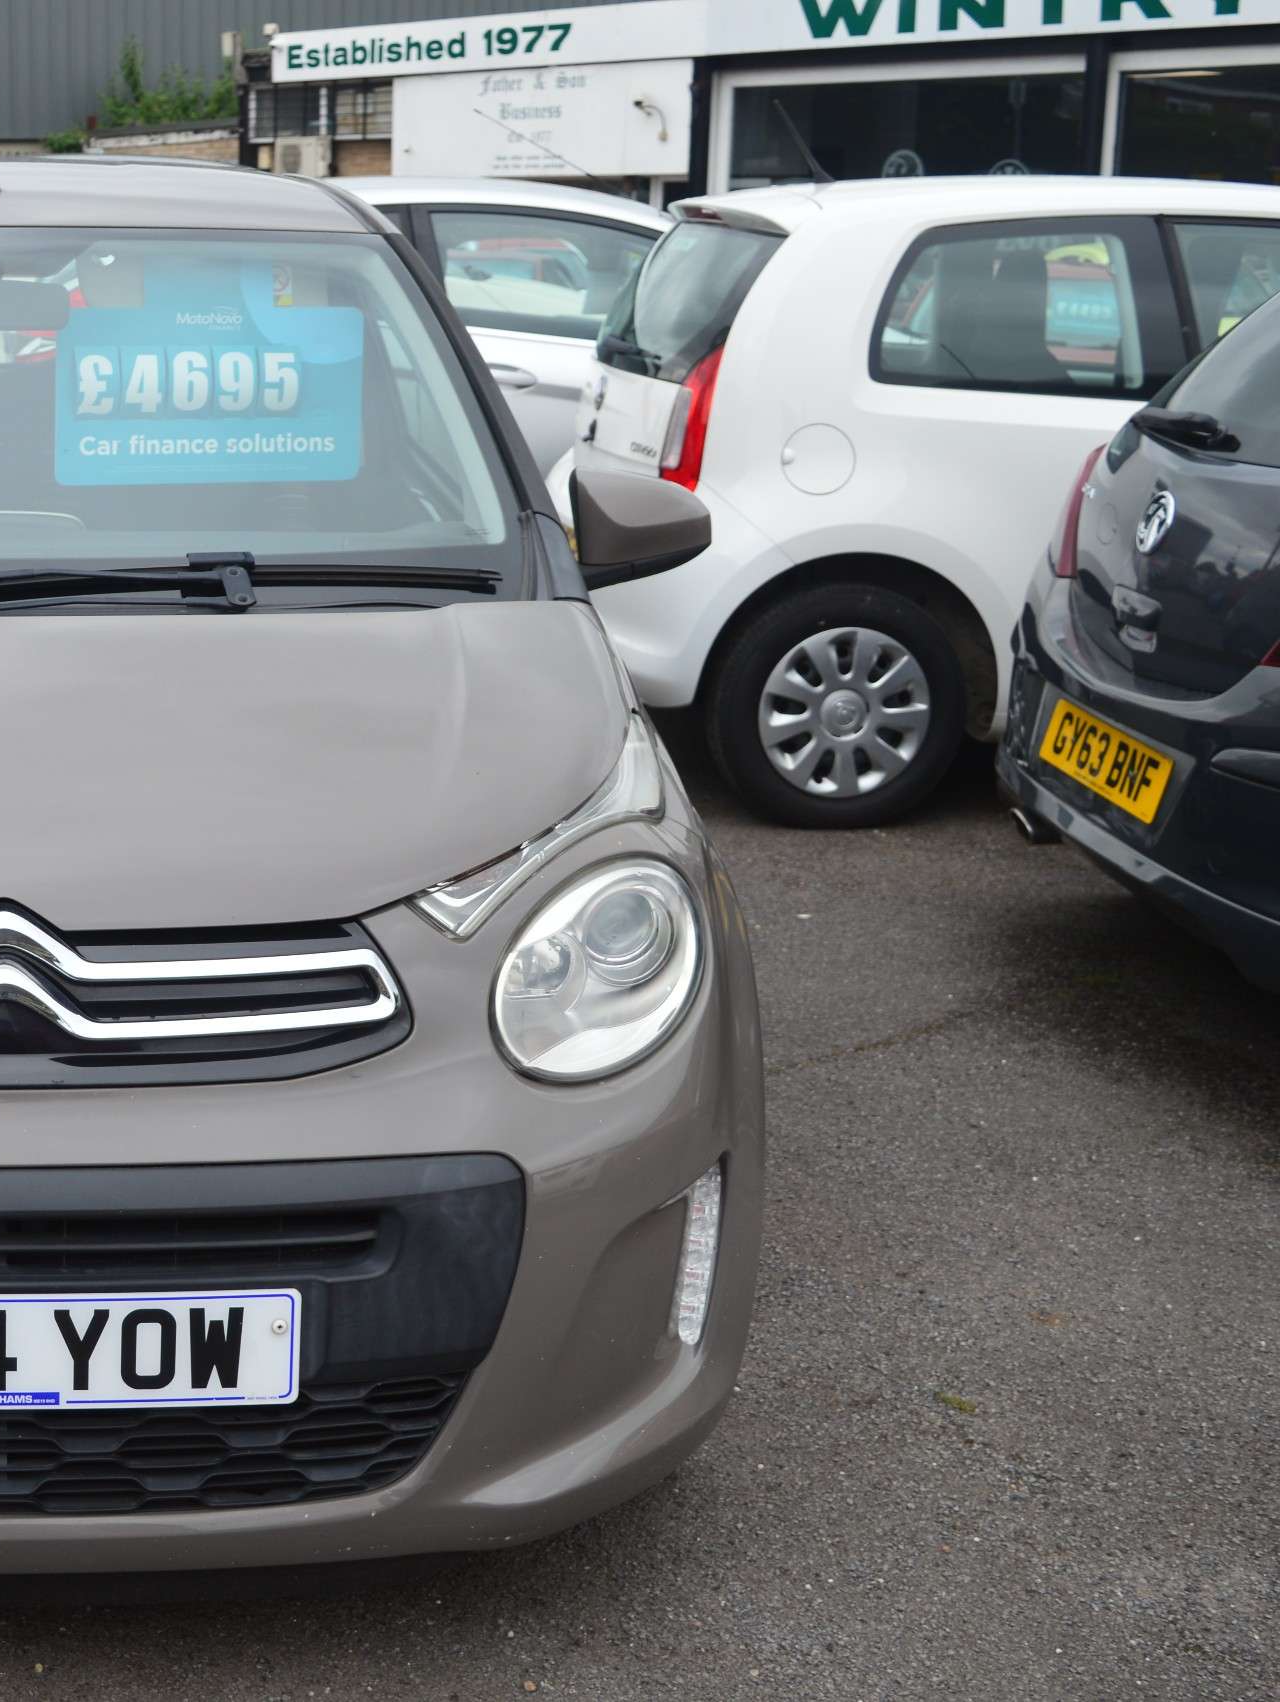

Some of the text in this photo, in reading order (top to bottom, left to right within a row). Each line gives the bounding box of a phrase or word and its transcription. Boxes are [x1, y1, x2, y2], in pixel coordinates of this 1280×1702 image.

[286, 23, 572, 69] Established 1977
[76, 350, 300, 416] £4695
[79, 432, 336, 456] Car finance solutions
[1052, 711, 1111, 777] GY63
[1105, 740, 1161, 803] BNF
[53, 1306, 245, 1391] YOW
